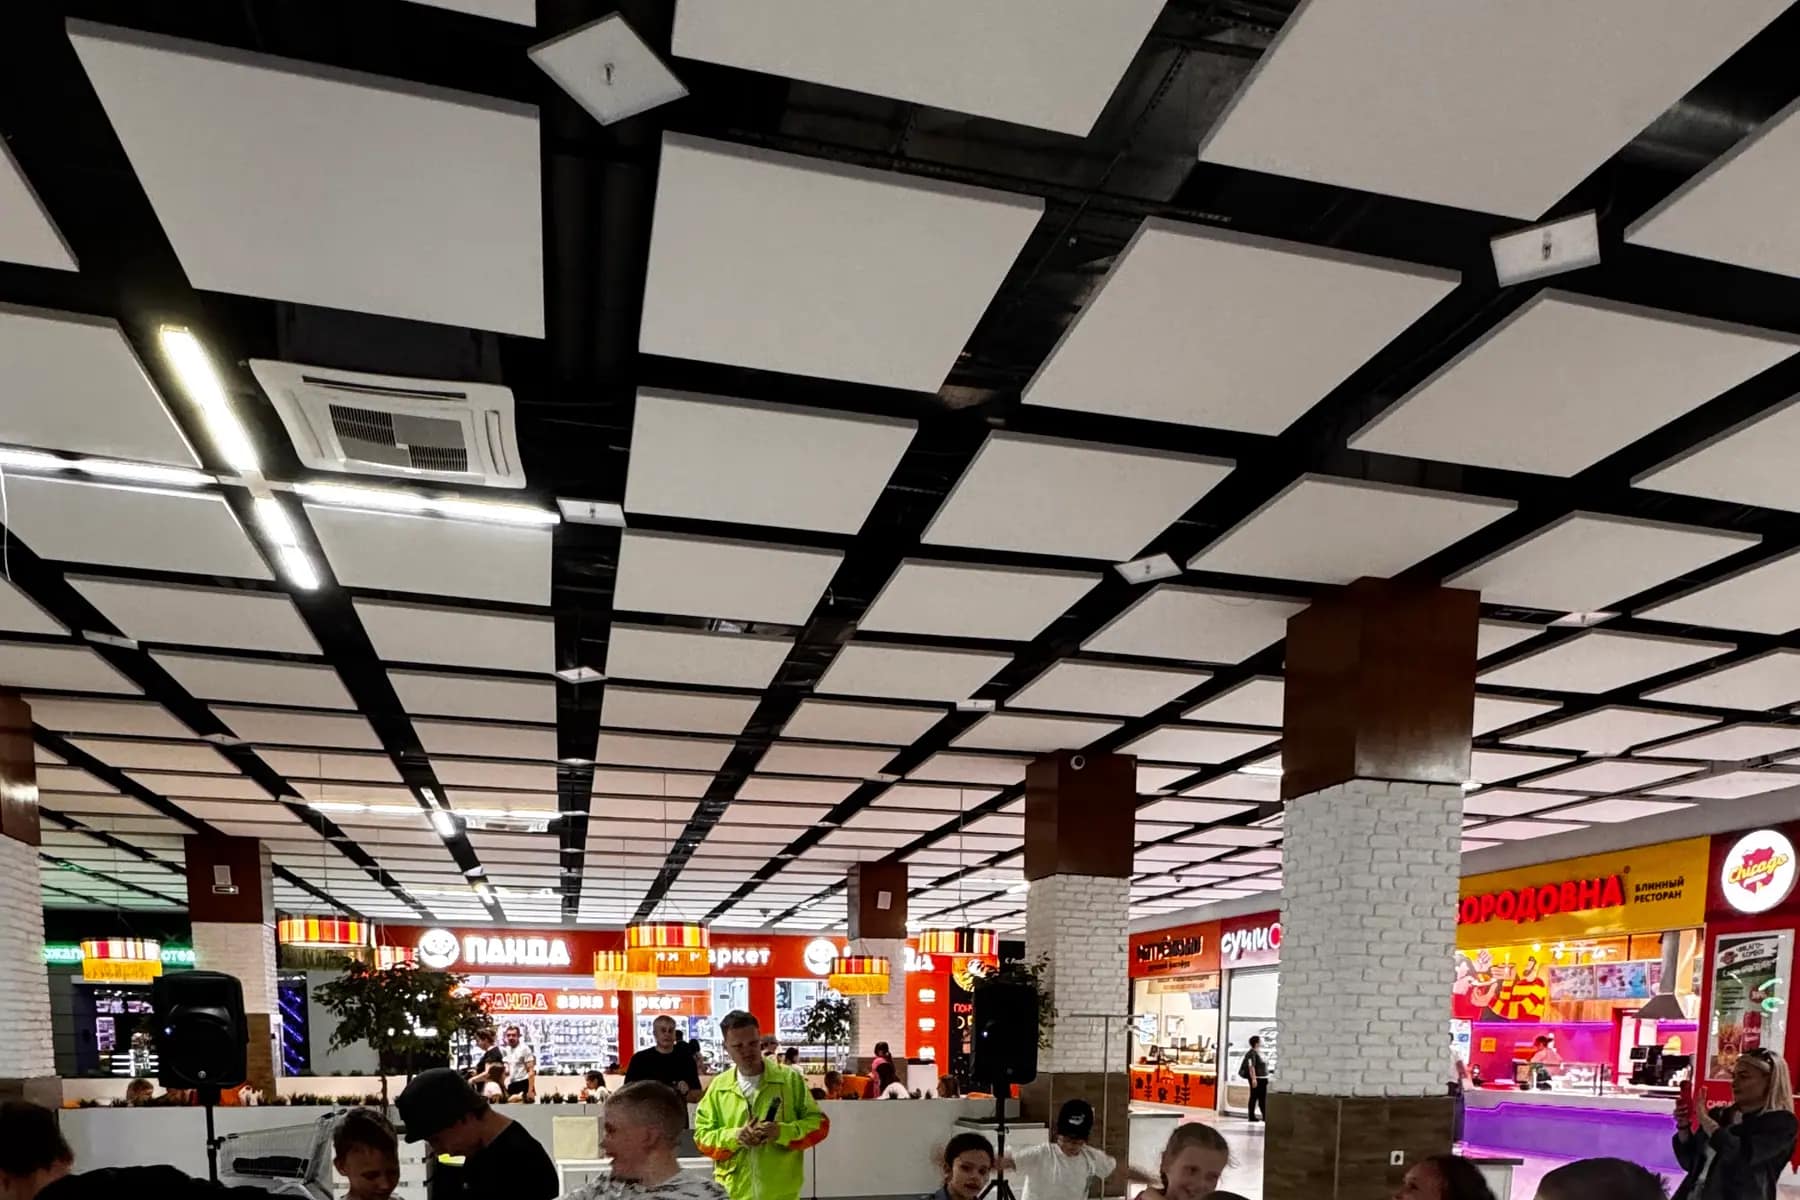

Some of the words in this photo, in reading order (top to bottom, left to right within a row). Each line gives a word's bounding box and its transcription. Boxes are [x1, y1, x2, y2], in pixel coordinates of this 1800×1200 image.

[1728, 853, 1789, 884] Chicago
[1456, 873, 1627, 924] ОРОДОВНА
[1634, 889, 1683, 904] РЕСТОРАН
[1635, 876, 1685, 893] БЛИННЫЙ
[463, 934, 571, 966] ПАНДА
